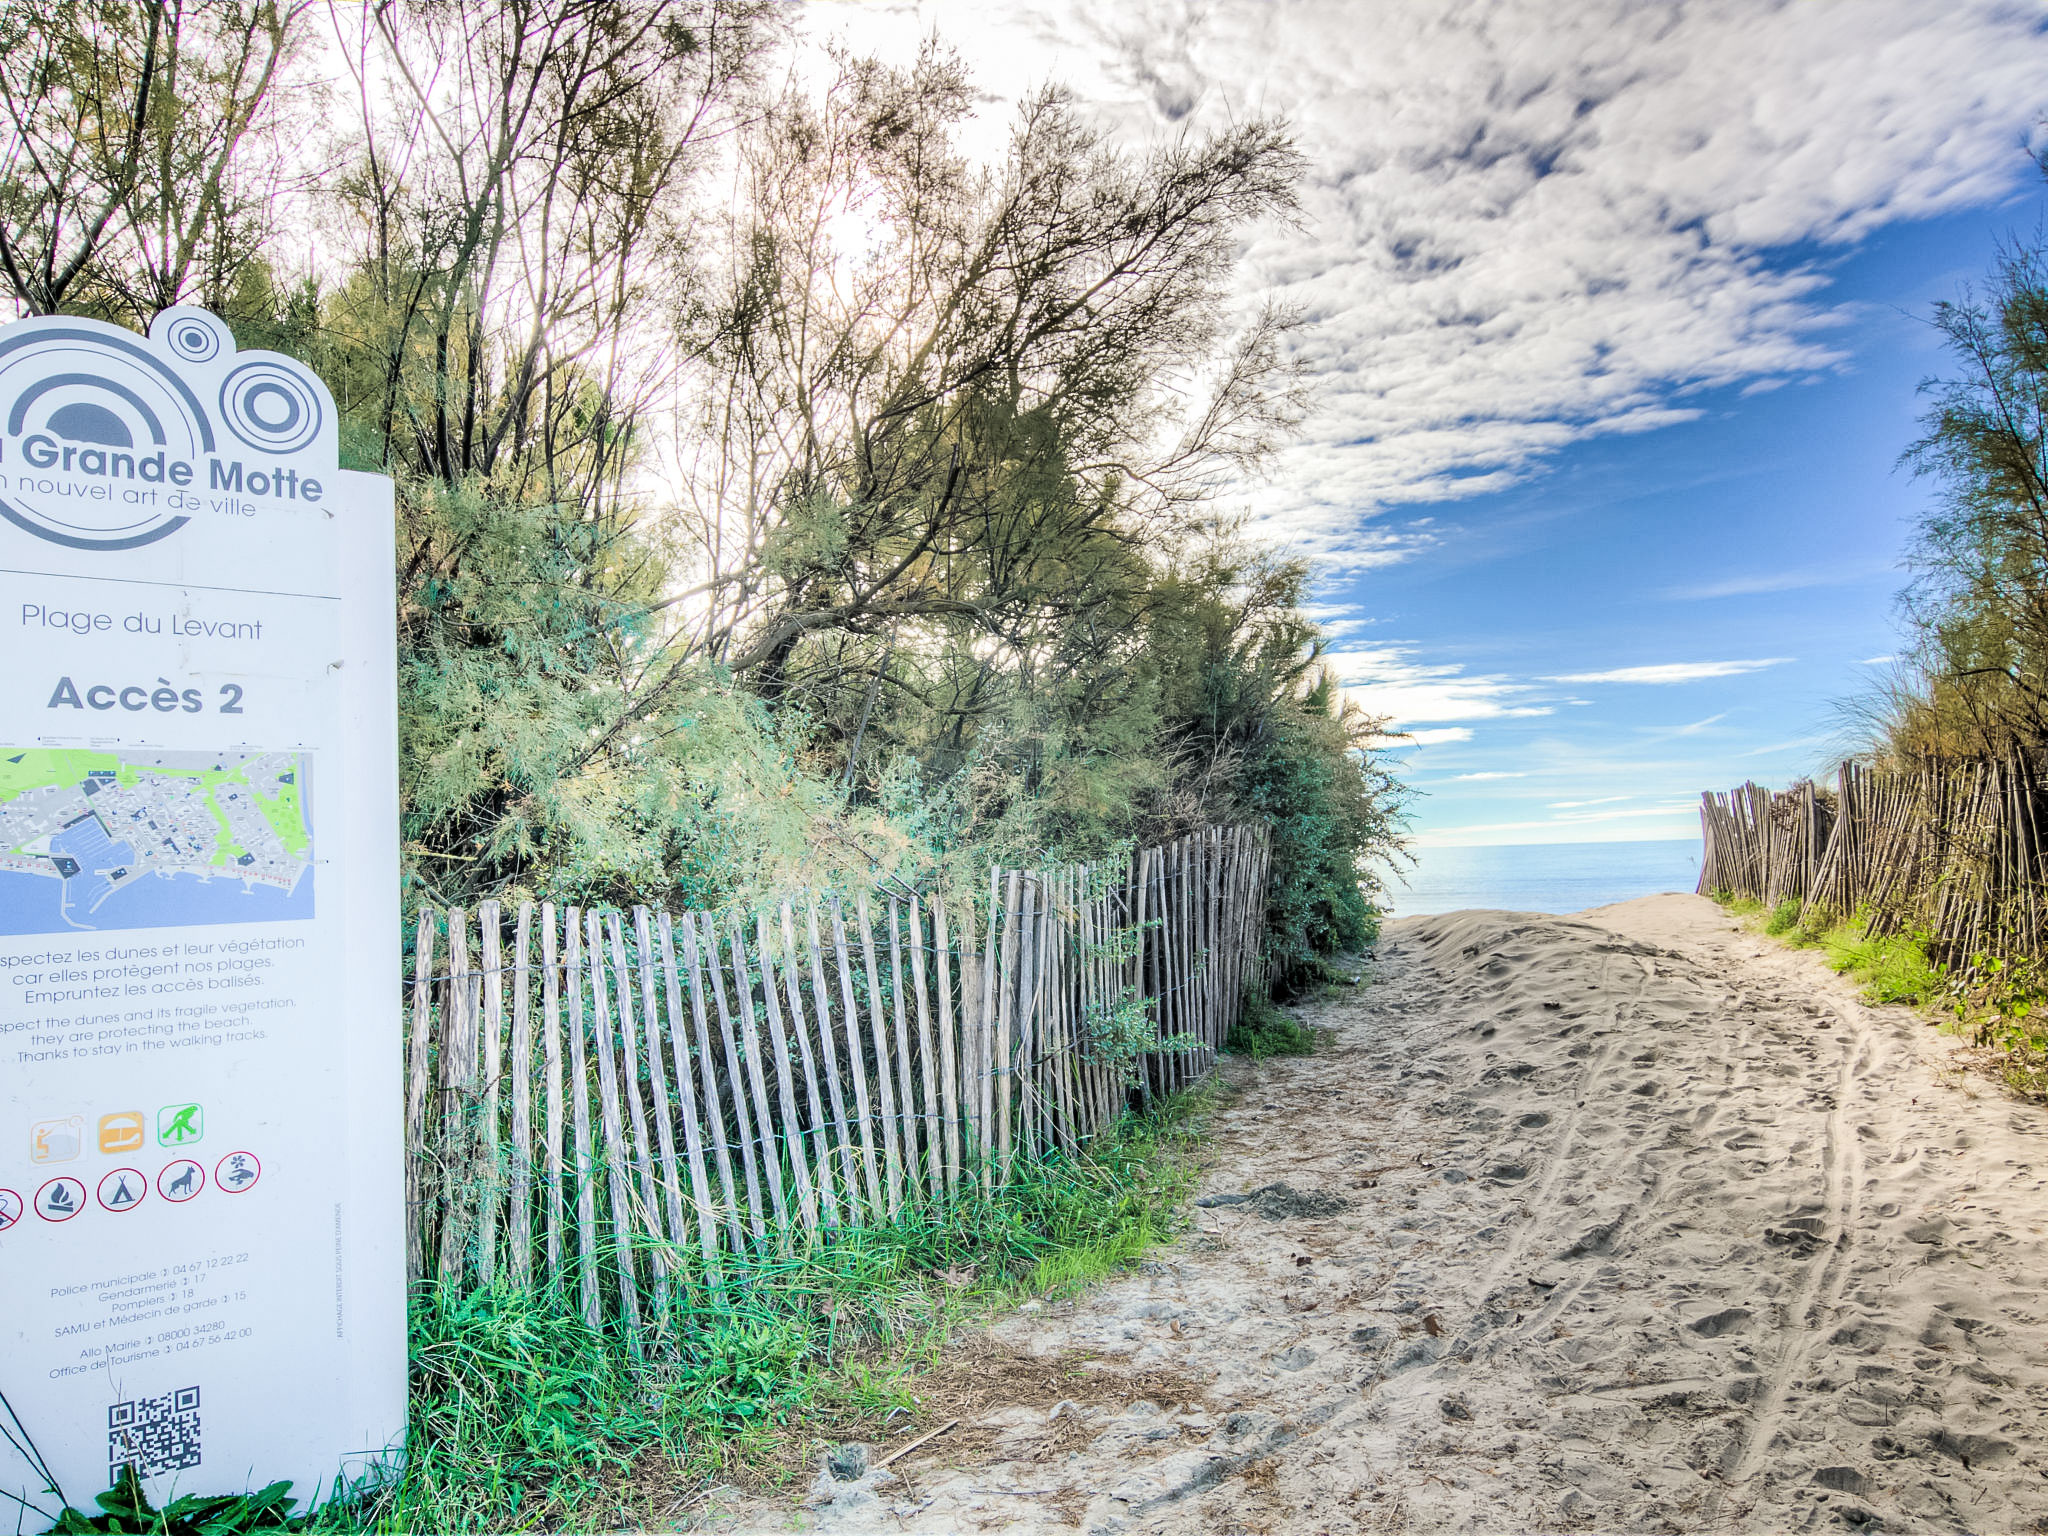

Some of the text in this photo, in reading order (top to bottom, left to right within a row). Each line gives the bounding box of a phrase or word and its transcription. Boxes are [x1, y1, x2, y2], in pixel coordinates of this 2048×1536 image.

[22, 434, 193, 486] Grande
[210, 458, 323, 502] Motte
[20, 476, 112, 501] nouvel
[123, 487, 158, 507] art
[168, 489, 200, 511] de
[210, 497, 256, 517] ville
[22, 604, 262, 640] Plage du Levant
[47, 676, 243, 714] Accès 2
[77, 949, 100, 962] les
[105, 947, 158, 960] dunes
[162, 944, 179, 957] et
[184, 943, 214, 955] leur
[218, 937, 305, 954] végétation
[13, 973, 44, 985] car
[49, 969, 88, 982] elles
[185, 962, 213, 973] nos
[217, 957, 275, 973] plages.
[25, 973, 265, 1004] Empruntez les accès balisés.
[46, 1017, 70, 1029] the
[75, 1014, 120, 1026] dunes
[124, 1008, 153, 1022] and
[157, 1007, 171, 1019] its
[175, 1004, 217, 1018] fragile
[18, 1049, 69, 1063] Thanks
[73, 1047, 88, 1057] to
[92, 1045, 121, 1056] stay
[126, 1042, 138, 1053] in
[143, 1039, 165, 1050] the
[169, 1034, 222, 1048] walking
[31, 1034, 64, 1046] they
[69, 1031, 94, 1042] are
[98, 1022, 174, 1042] protecting
[178, 1021, 200, 1032] the
[50, 1253, 249, 1298] Police municipale 04 67 12 22 22
[98, 1273, 206, 1302] Gendarmerie 17
[55, 1290, 247, 1338] SAMU et Médecin de garde 15
[112, 1288, 194, 1312] Pompiers 18
[49, 1364, 87, 1379] Office
[90, 1360, 107, 1370] de
[111, 1348, 160, 1366] Tourisme
[176, 1341, 190, 1352] 04
[224, 1331, 237, 1340] 42
[239, 1327, 252, 1338] 00
[105, 1339, 141, 1354] Mairie
[158, 1328, 191, 1343] 08000
